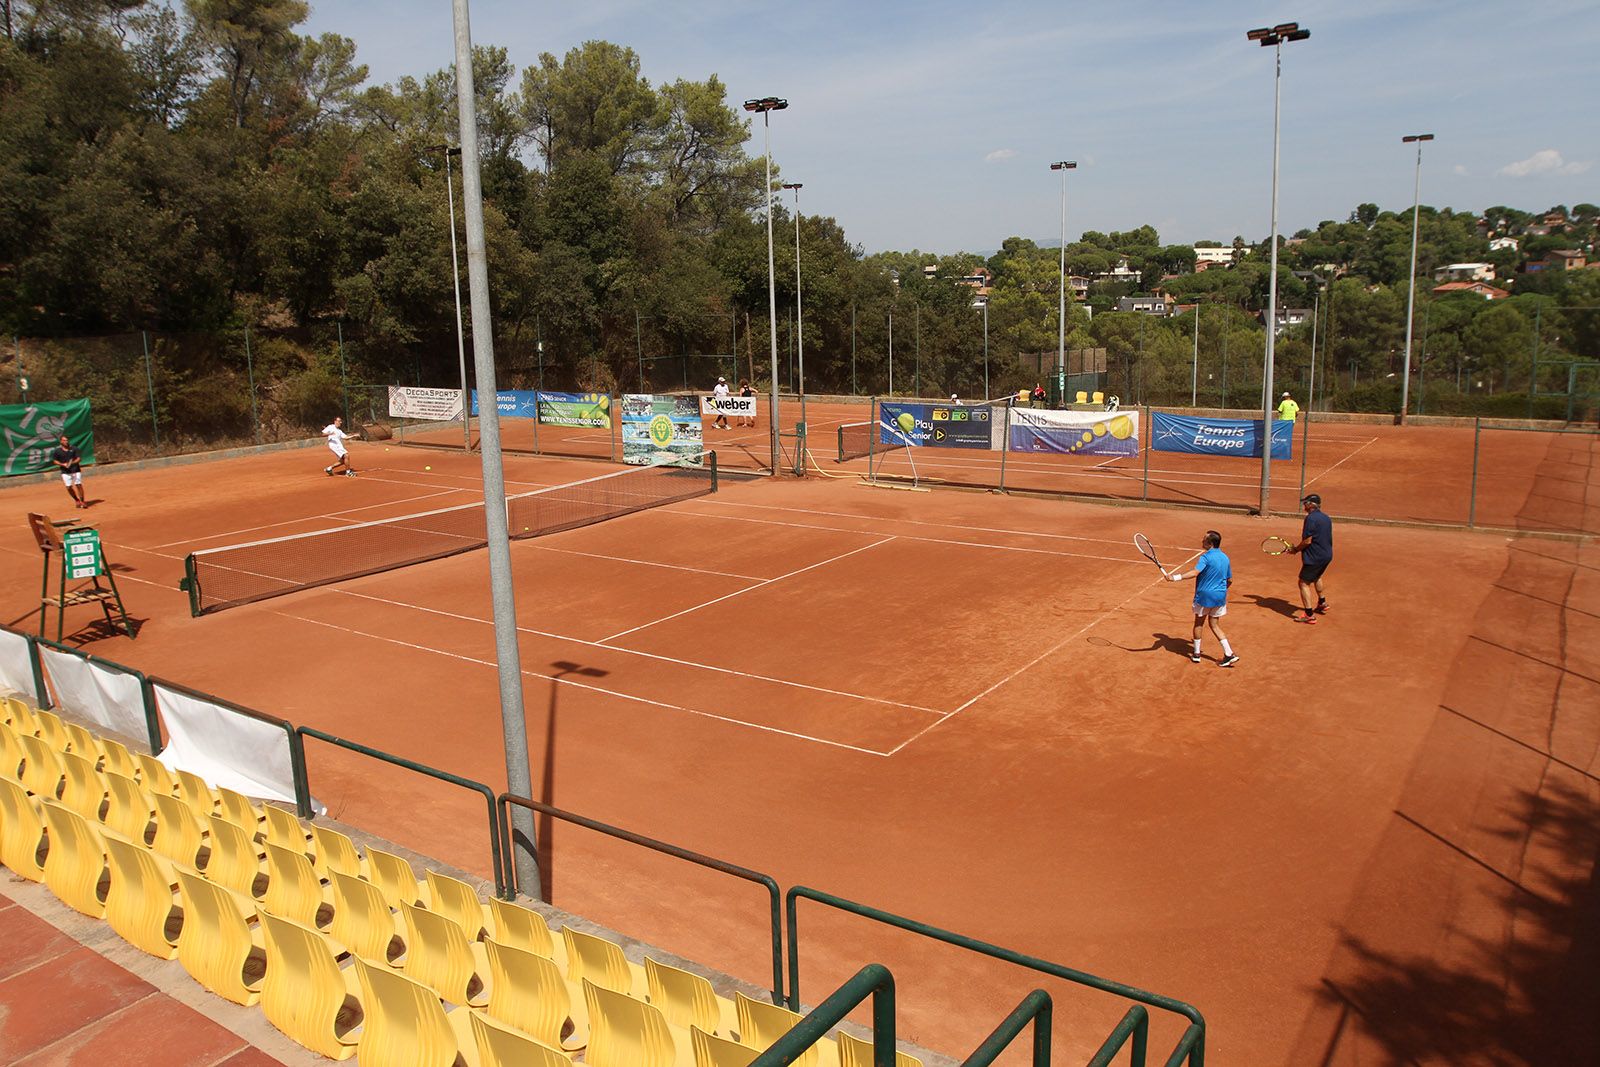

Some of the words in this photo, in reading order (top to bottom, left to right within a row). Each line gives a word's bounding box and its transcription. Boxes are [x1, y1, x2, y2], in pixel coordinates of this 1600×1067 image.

[496, 393, 516, 402] ennis
[496, 403, 516, 411] urope
[715, 398, 751, 410] weber
[1016, 412, 1047, 425] TENIS
[915, 419, 934, 430] Play
[908, 431, 931, 440] Senior
[1197, 424, 1245, 437] Tennis
[1193, 435, 1245, 450] Europe
